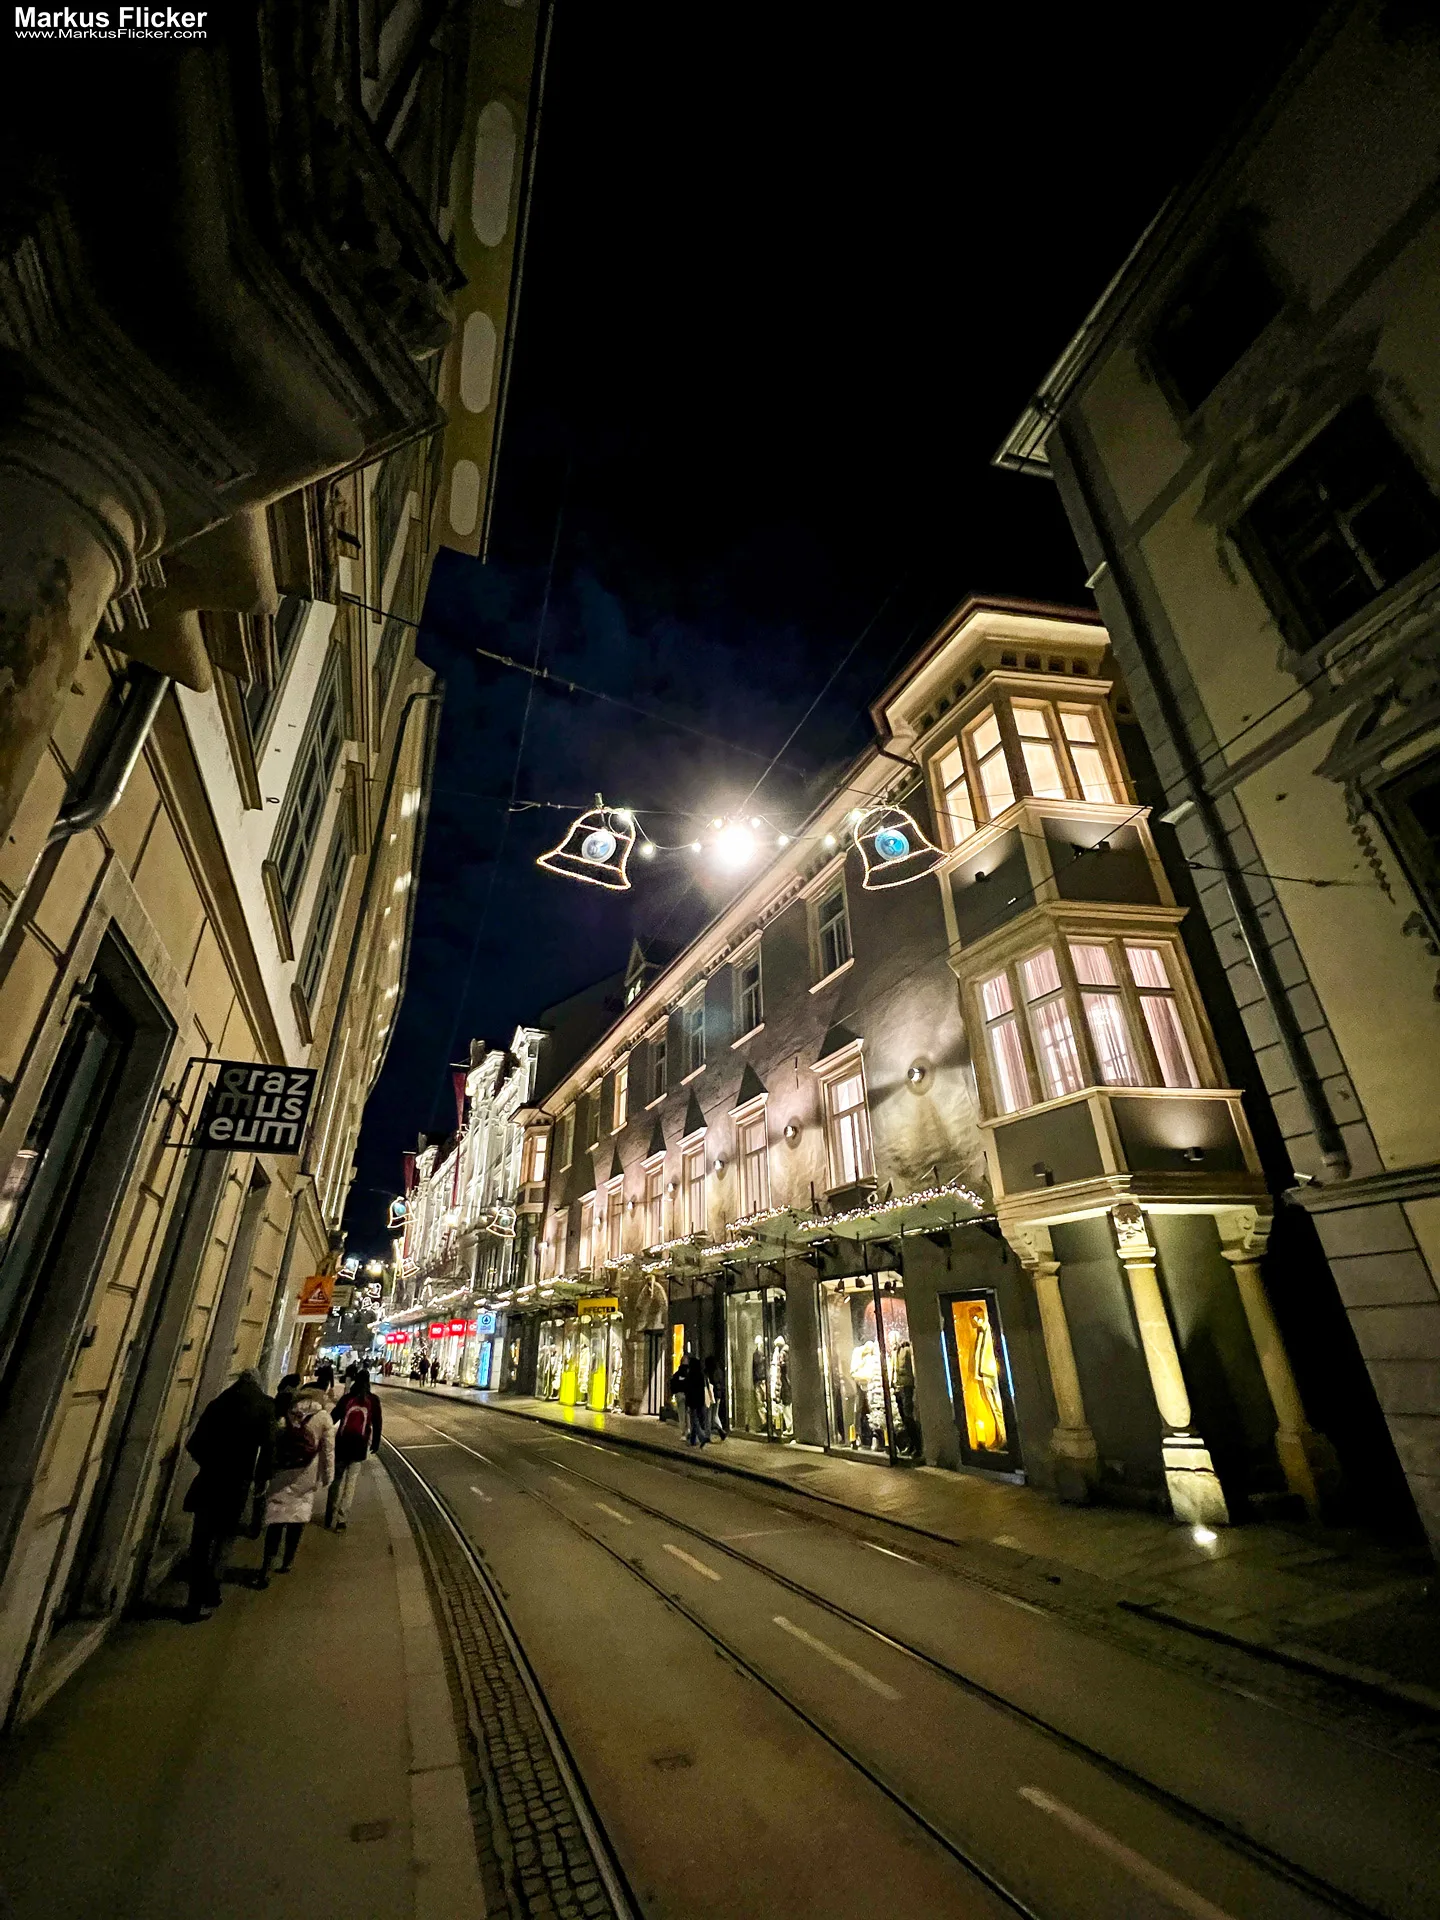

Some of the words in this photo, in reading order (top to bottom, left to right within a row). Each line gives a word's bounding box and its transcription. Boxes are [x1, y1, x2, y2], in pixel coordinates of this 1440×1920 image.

[223, 1068, 310, 1096] graz
[215, 1091, 304, 1120] mus
[208, 1117, 299, 1145] eum
